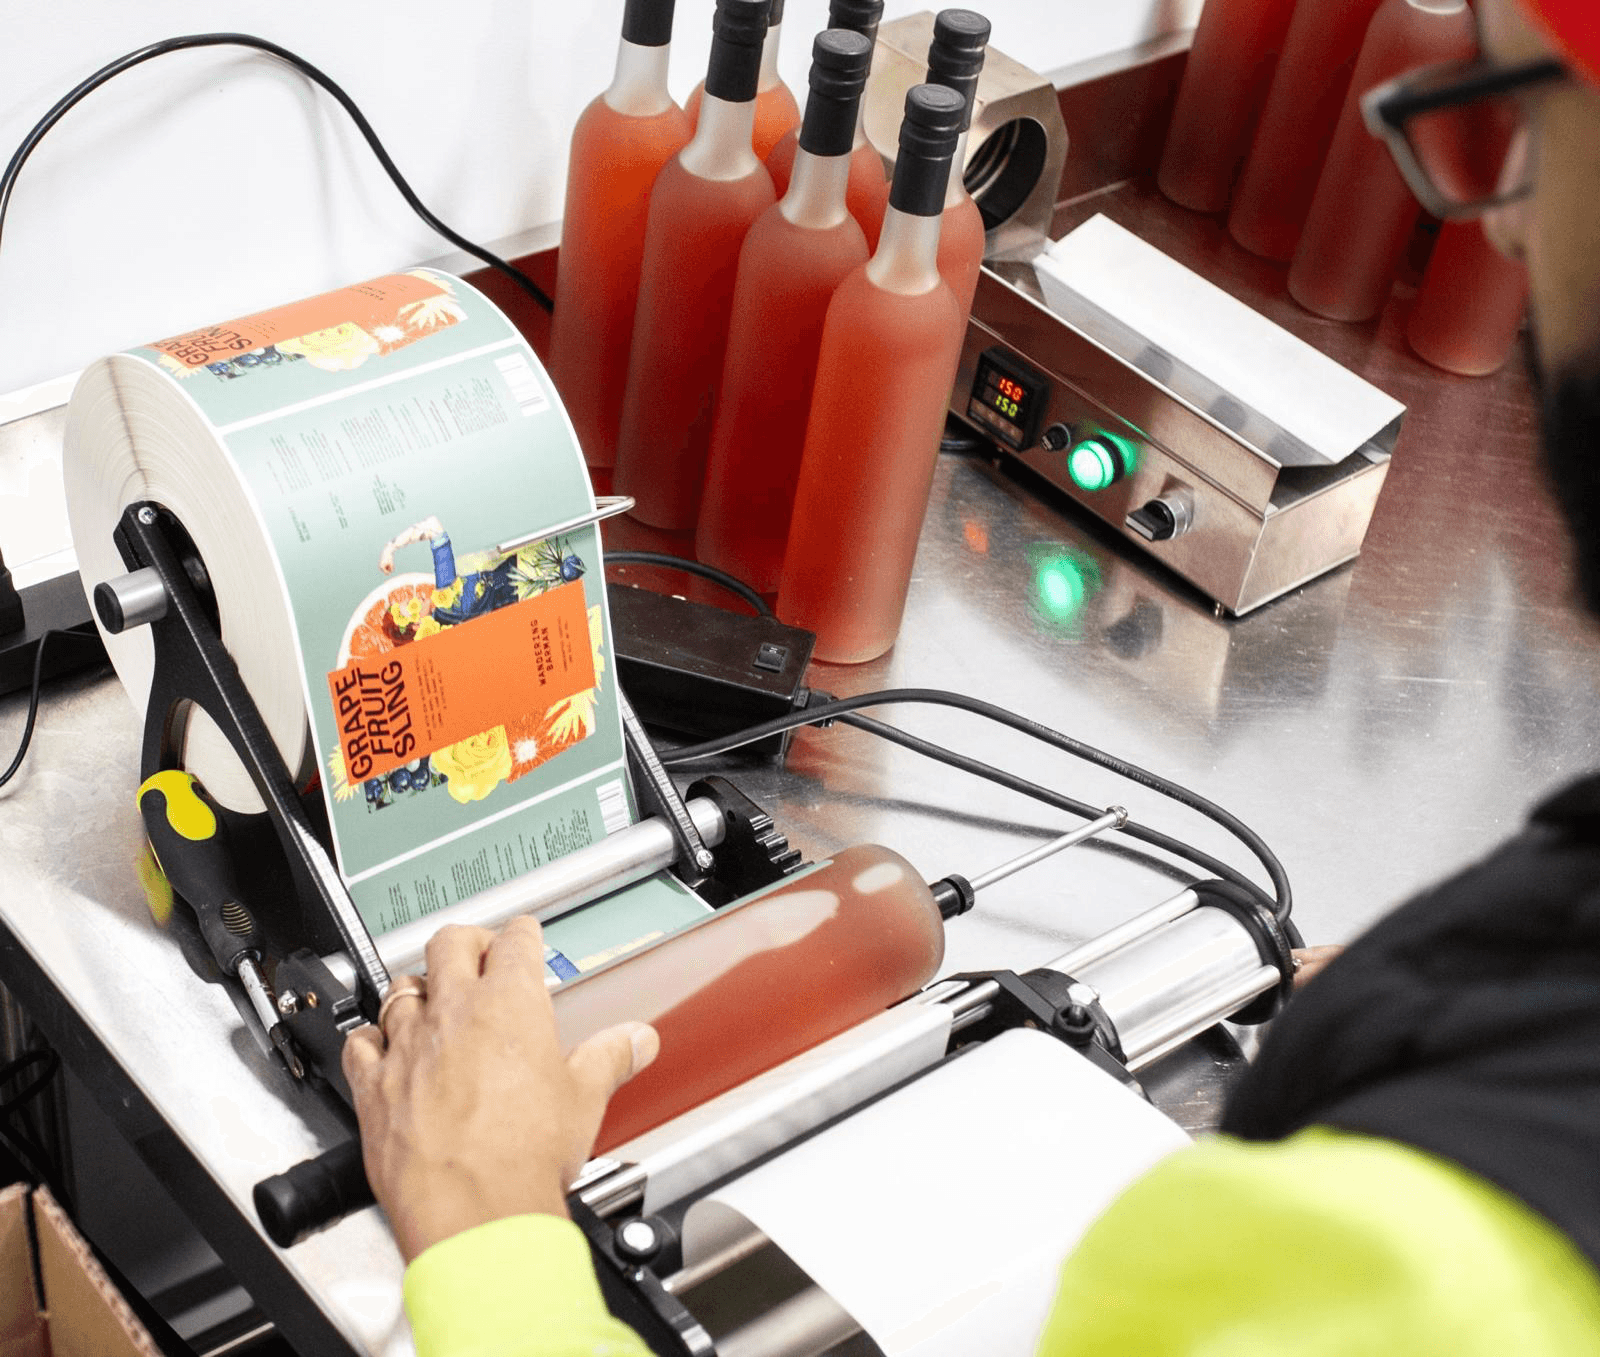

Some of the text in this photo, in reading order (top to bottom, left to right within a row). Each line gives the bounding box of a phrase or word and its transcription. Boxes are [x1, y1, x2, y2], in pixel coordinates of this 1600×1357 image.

[995, 394, 1018, 417] 150
[999, 378, 1023, 401] 150
[530, 619, 546, 686] WANDERING
[540, 626, 553, 671] BARMAN
[335, 668, 373, 779] GRAPE
[356, 667, 393, 755] FRUIT
[381, 660, 415, 758] SLING
